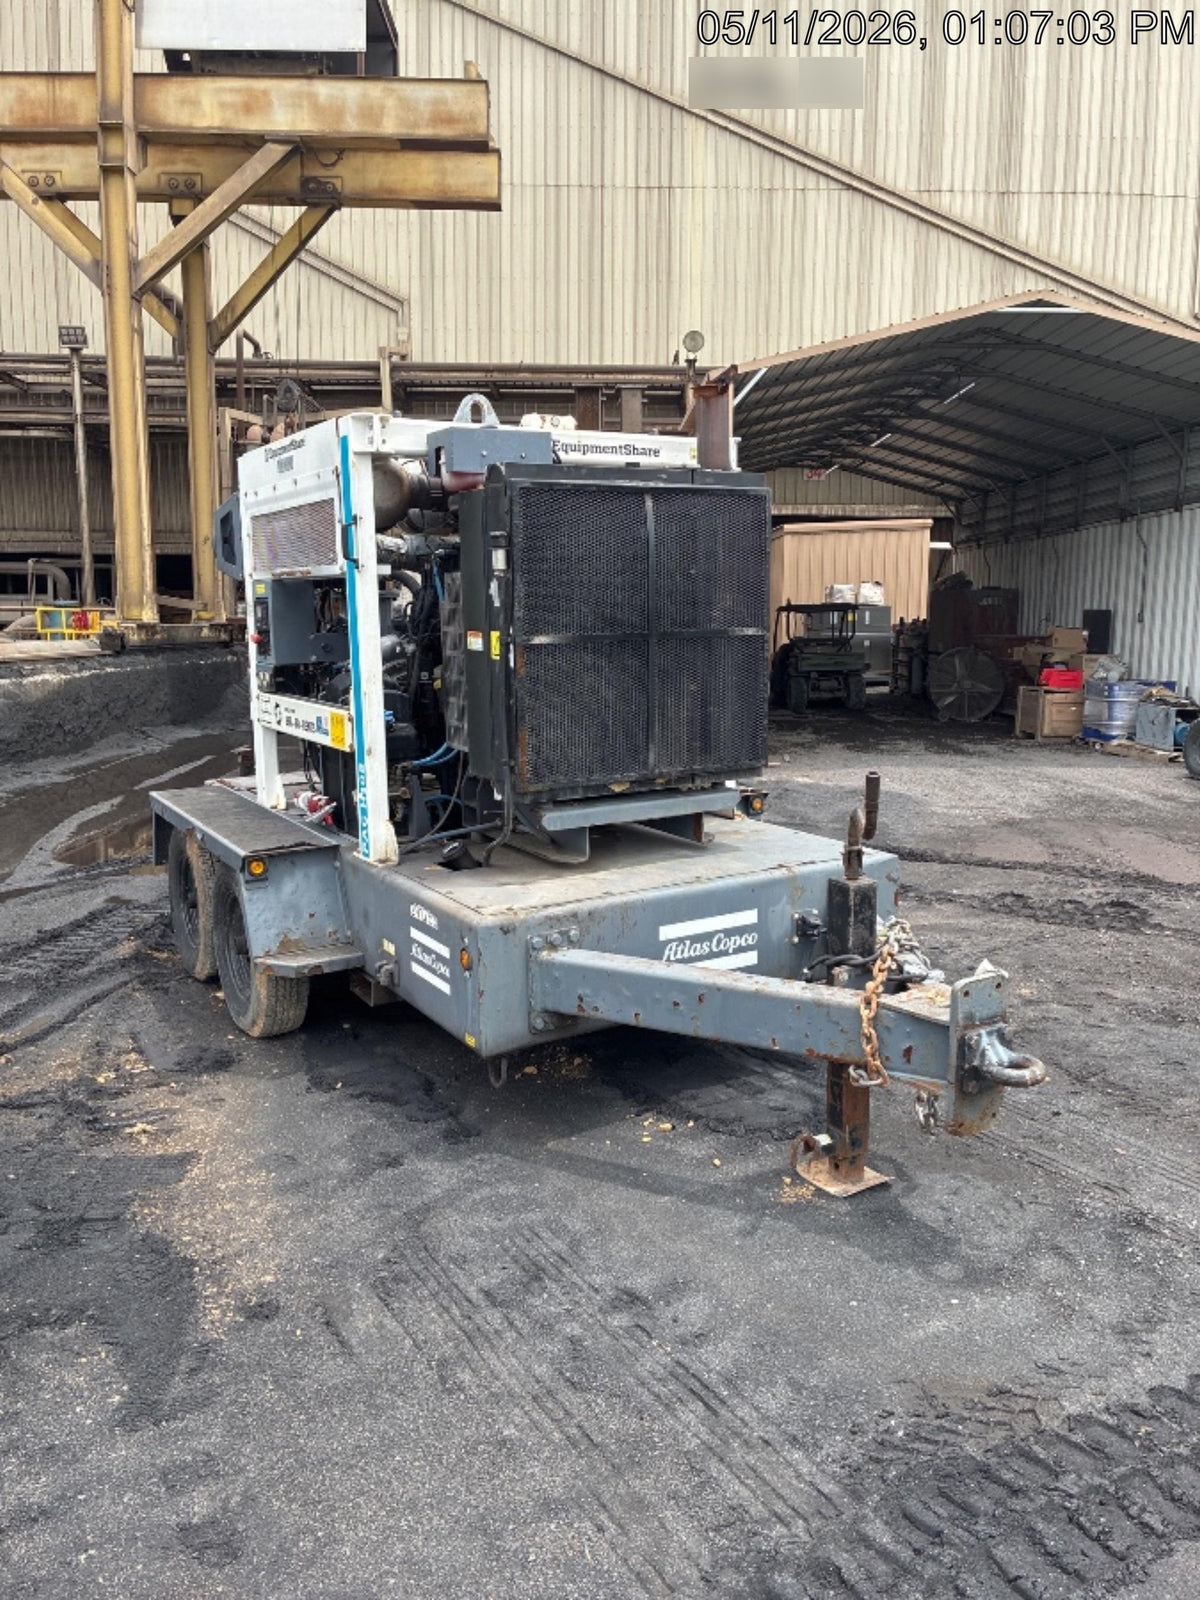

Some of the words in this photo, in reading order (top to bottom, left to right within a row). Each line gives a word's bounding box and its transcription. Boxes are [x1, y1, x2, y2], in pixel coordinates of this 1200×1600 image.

[552, 440, 660, 458] EquipmentShare
[662, 939, 711, 963] Atlas
[711, 932, 758, 954] Copco
